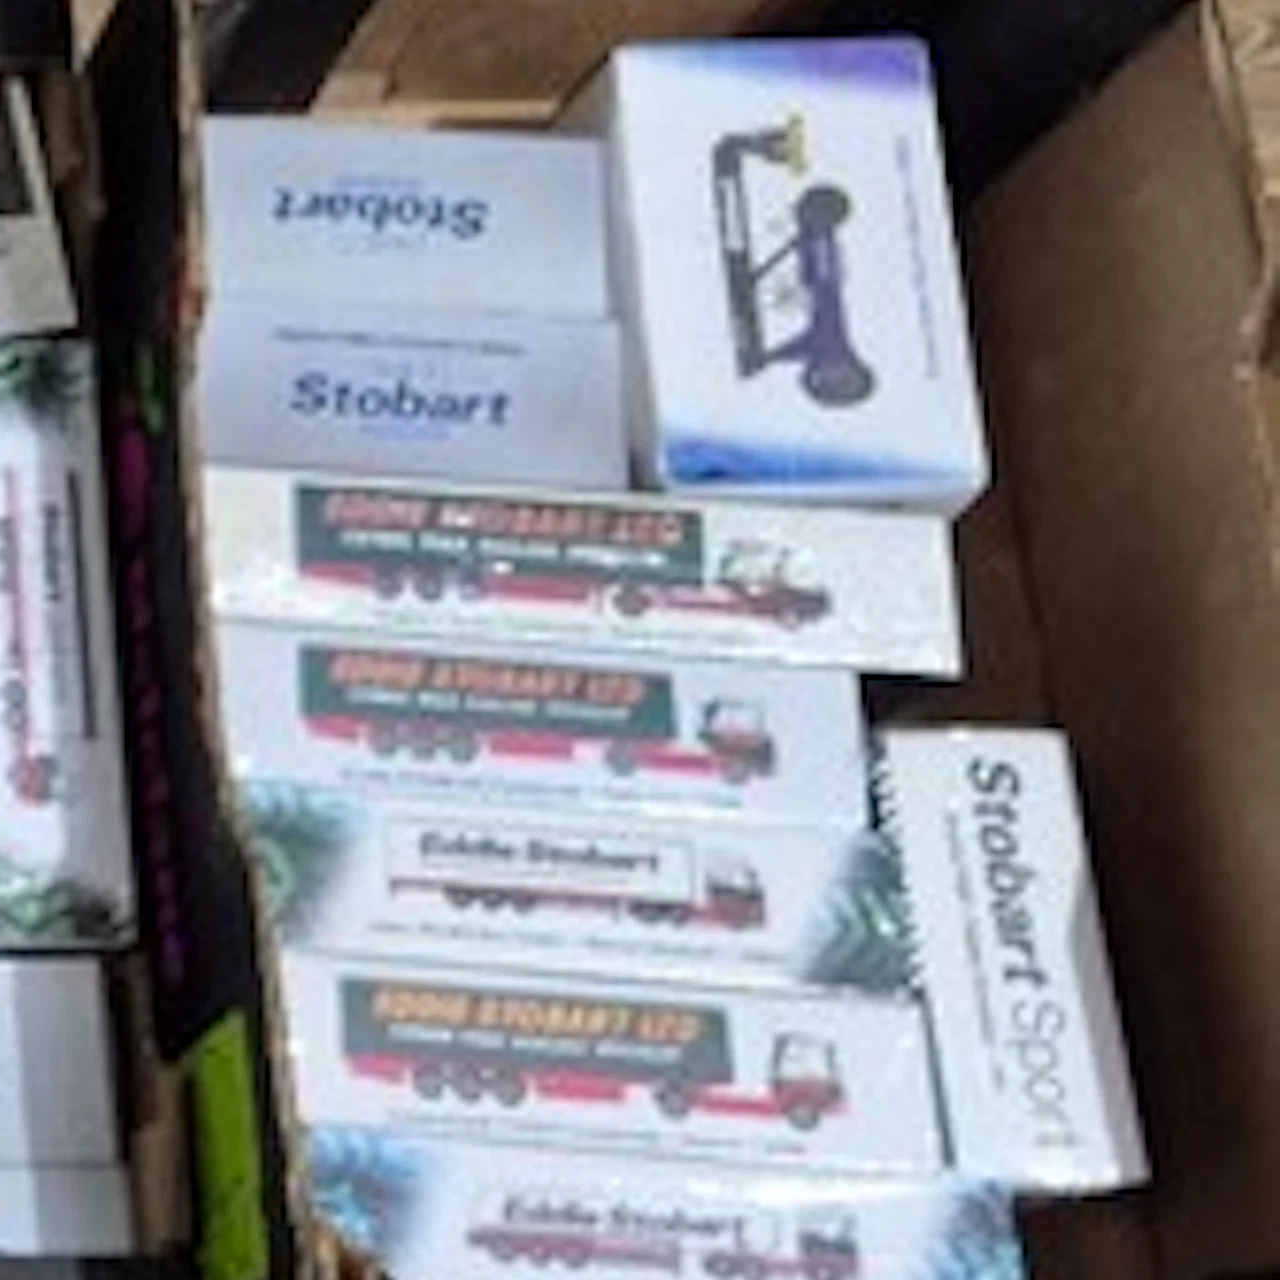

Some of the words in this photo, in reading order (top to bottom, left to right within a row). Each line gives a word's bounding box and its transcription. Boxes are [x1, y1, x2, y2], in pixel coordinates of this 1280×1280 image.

[272, 186, 490, 241] Stobart
[290, 371, 510, 428] Stobart
[965, 756, 1050, 988] Stobart
[1005, 997, 1085, 1149] Sport
